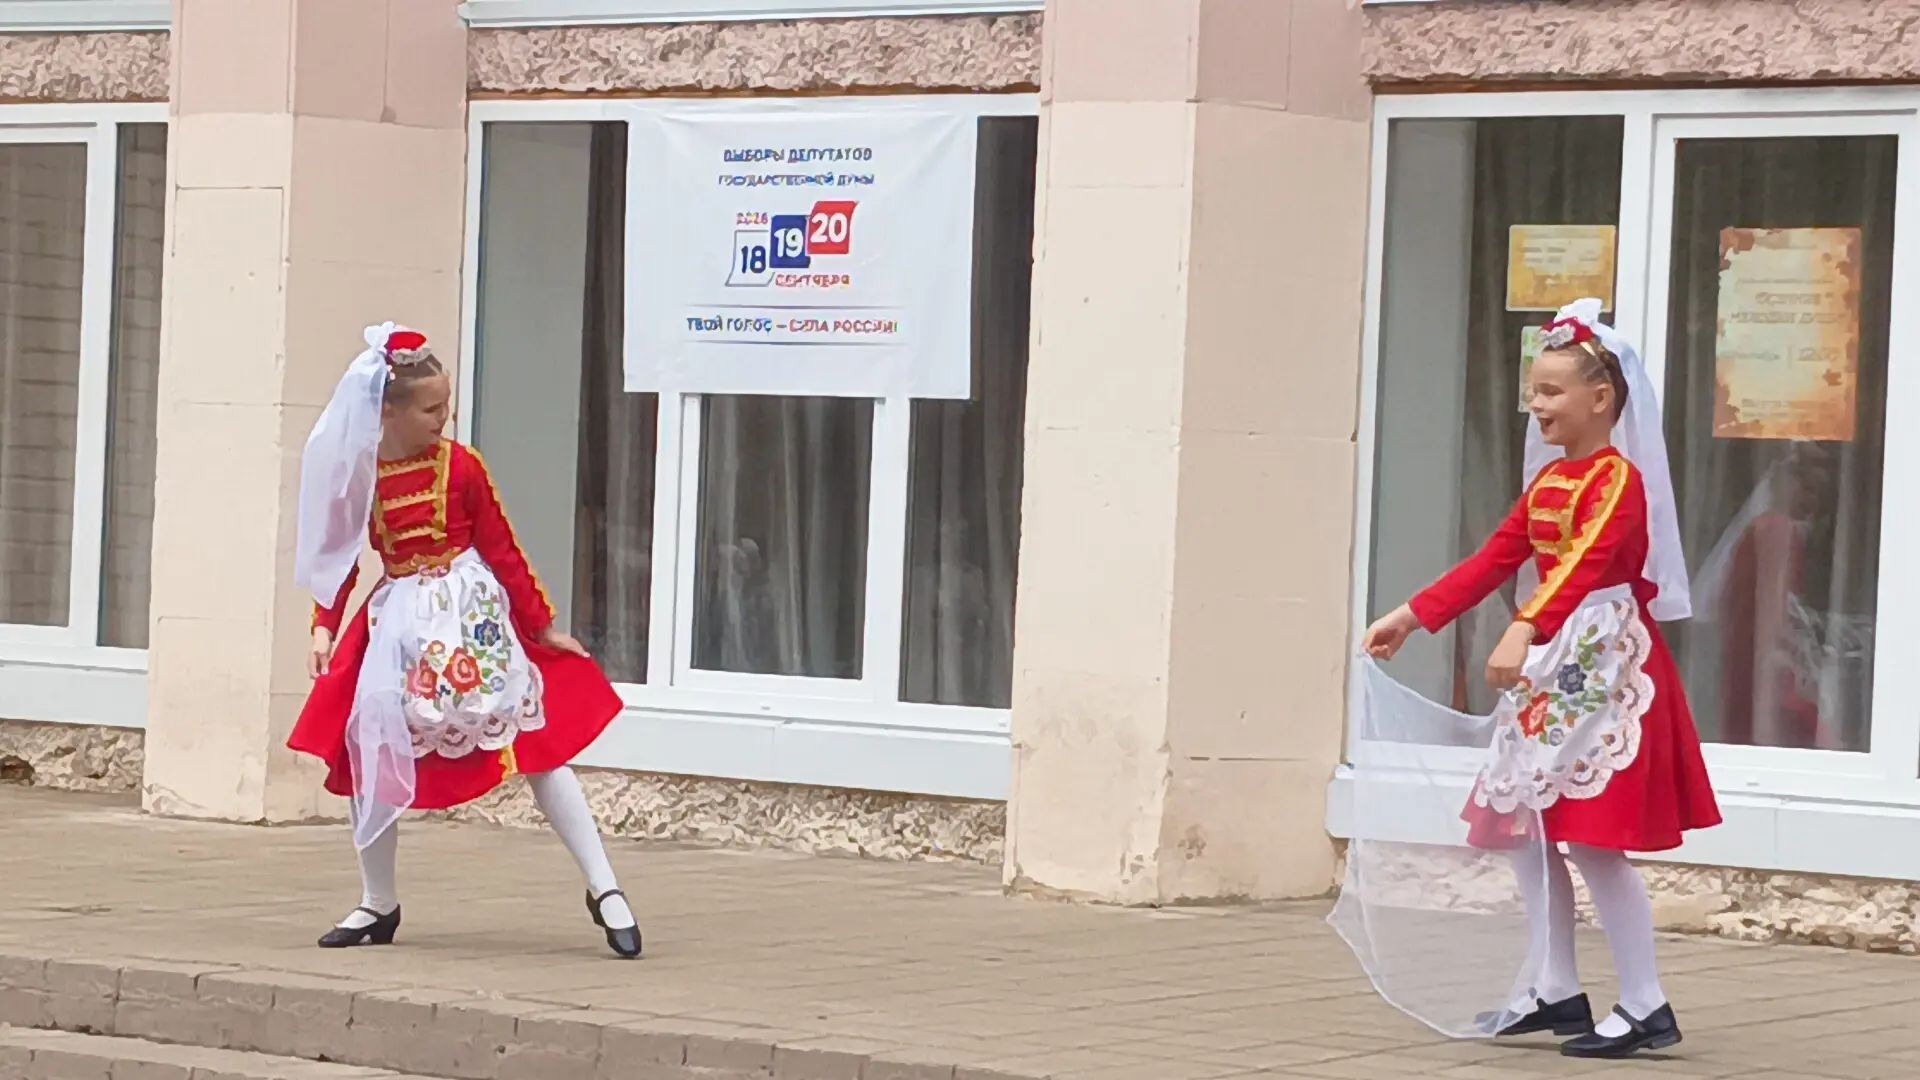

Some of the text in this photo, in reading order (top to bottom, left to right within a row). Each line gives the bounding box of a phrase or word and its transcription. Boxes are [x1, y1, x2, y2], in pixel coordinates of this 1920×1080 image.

[741, 212, 848, 274] 18 19 20
[686, 315, 723, 331] ТВОЙ
[726, 317, 773, 332] ГОЛОС
[789, 318, 829, 333] СИЛА
